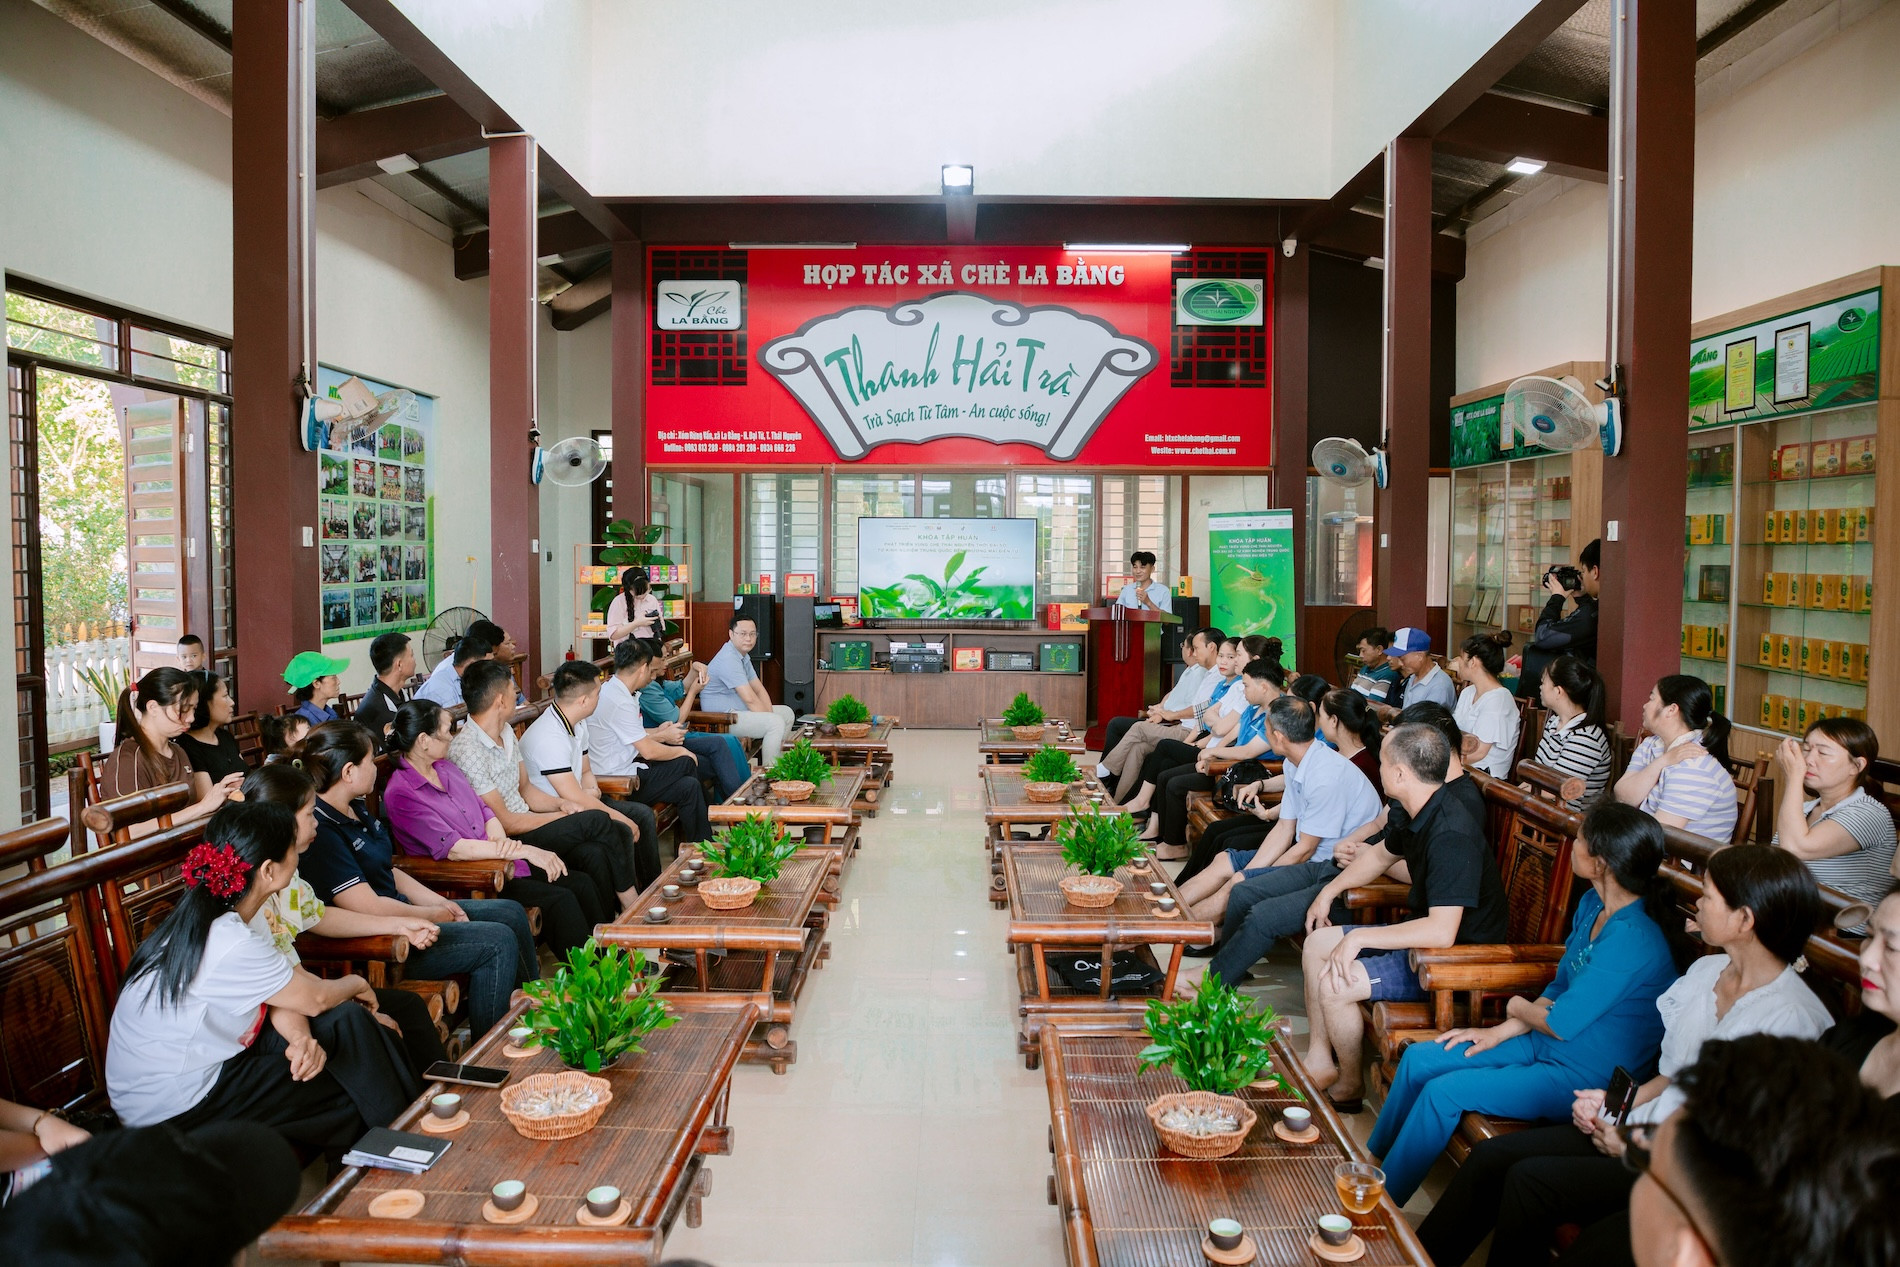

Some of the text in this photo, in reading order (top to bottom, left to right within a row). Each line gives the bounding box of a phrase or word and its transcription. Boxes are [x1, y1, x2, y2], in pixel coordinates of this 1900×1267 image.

[803, 257, 1125, 290] HỢP TÁC XÃ CHÈ LA BẰNG
[692, 314, 728, 324] BẰNG
[706, 305, 728, 315] Chè
[824, 321, 1081, 407] Thanh Hải Trà
[863, 412, 884, 431] Trà
[886, 407, 915, 427] Sạch
[935, 403, 959, 420] Tâm
[969, 403, 986, 418] An
[989, 404, 1017, 421] cuộc
[1018, 404, 1051, 427] sống!
[1145, 434, 1164, 442] Email:
